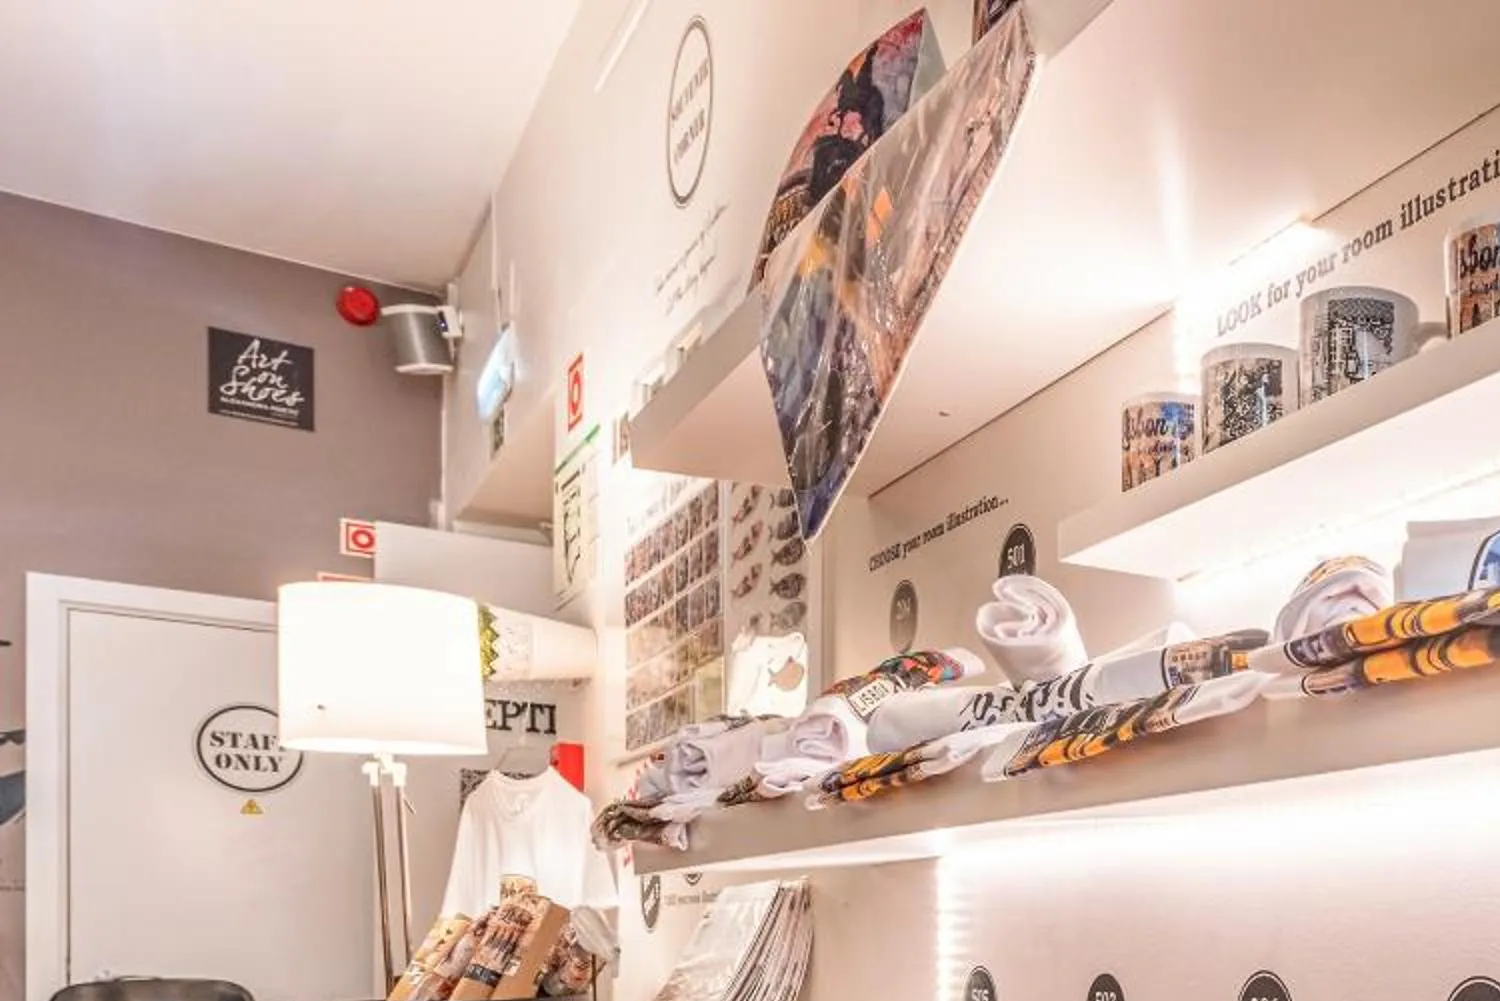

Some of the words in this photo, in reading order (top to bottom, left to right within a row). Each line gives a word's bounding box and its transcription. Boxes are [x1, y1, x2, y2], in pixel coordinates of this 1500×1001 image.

[1216, 291, 1263, 339] LOOK
[1267, 274, 1291, 308] for
[1295, 251, 1338, 297] your
[1341, 223, 1394, 265] room
[237, 338, 293, 370] Art
[219, 365, 306, 407] Shoes
[255, 370, 289, 389] on
[208, 731, 287, 753] STAF
[215, 753, 284, 773] ONLY
